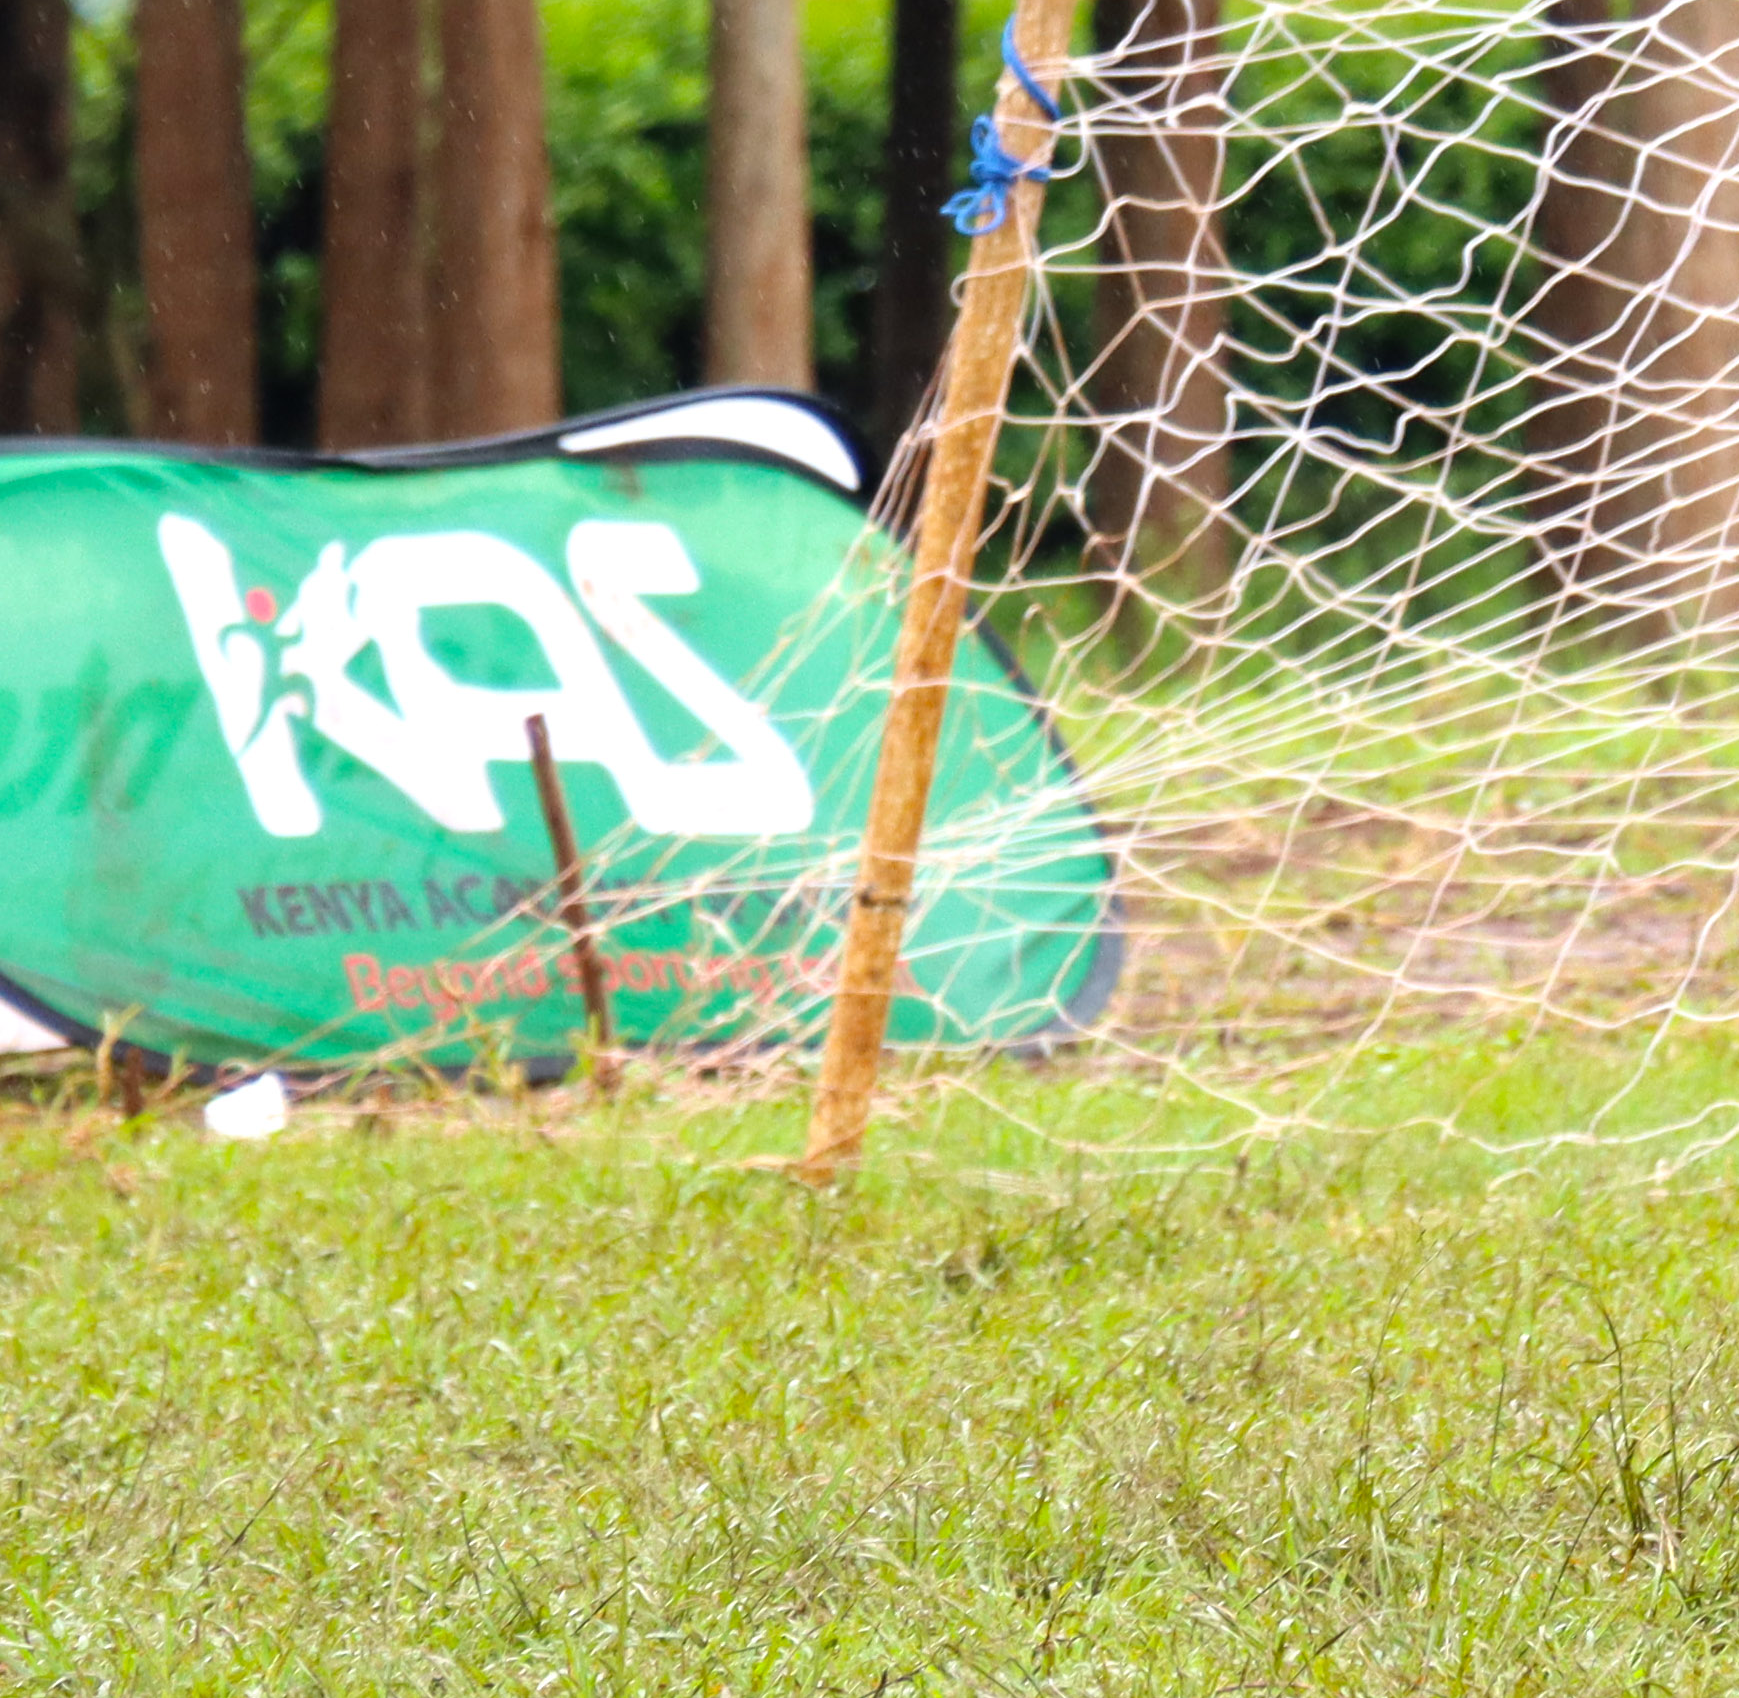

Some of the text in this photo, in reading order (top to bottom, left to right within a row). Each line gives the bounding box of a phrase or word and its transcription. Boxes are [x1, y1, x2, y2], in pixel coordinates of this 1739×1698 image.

[157, 511, 815, 838] KAS
[236, 878, 423, 940] KENYA
[342, 945, 551, 1023] Beyond
